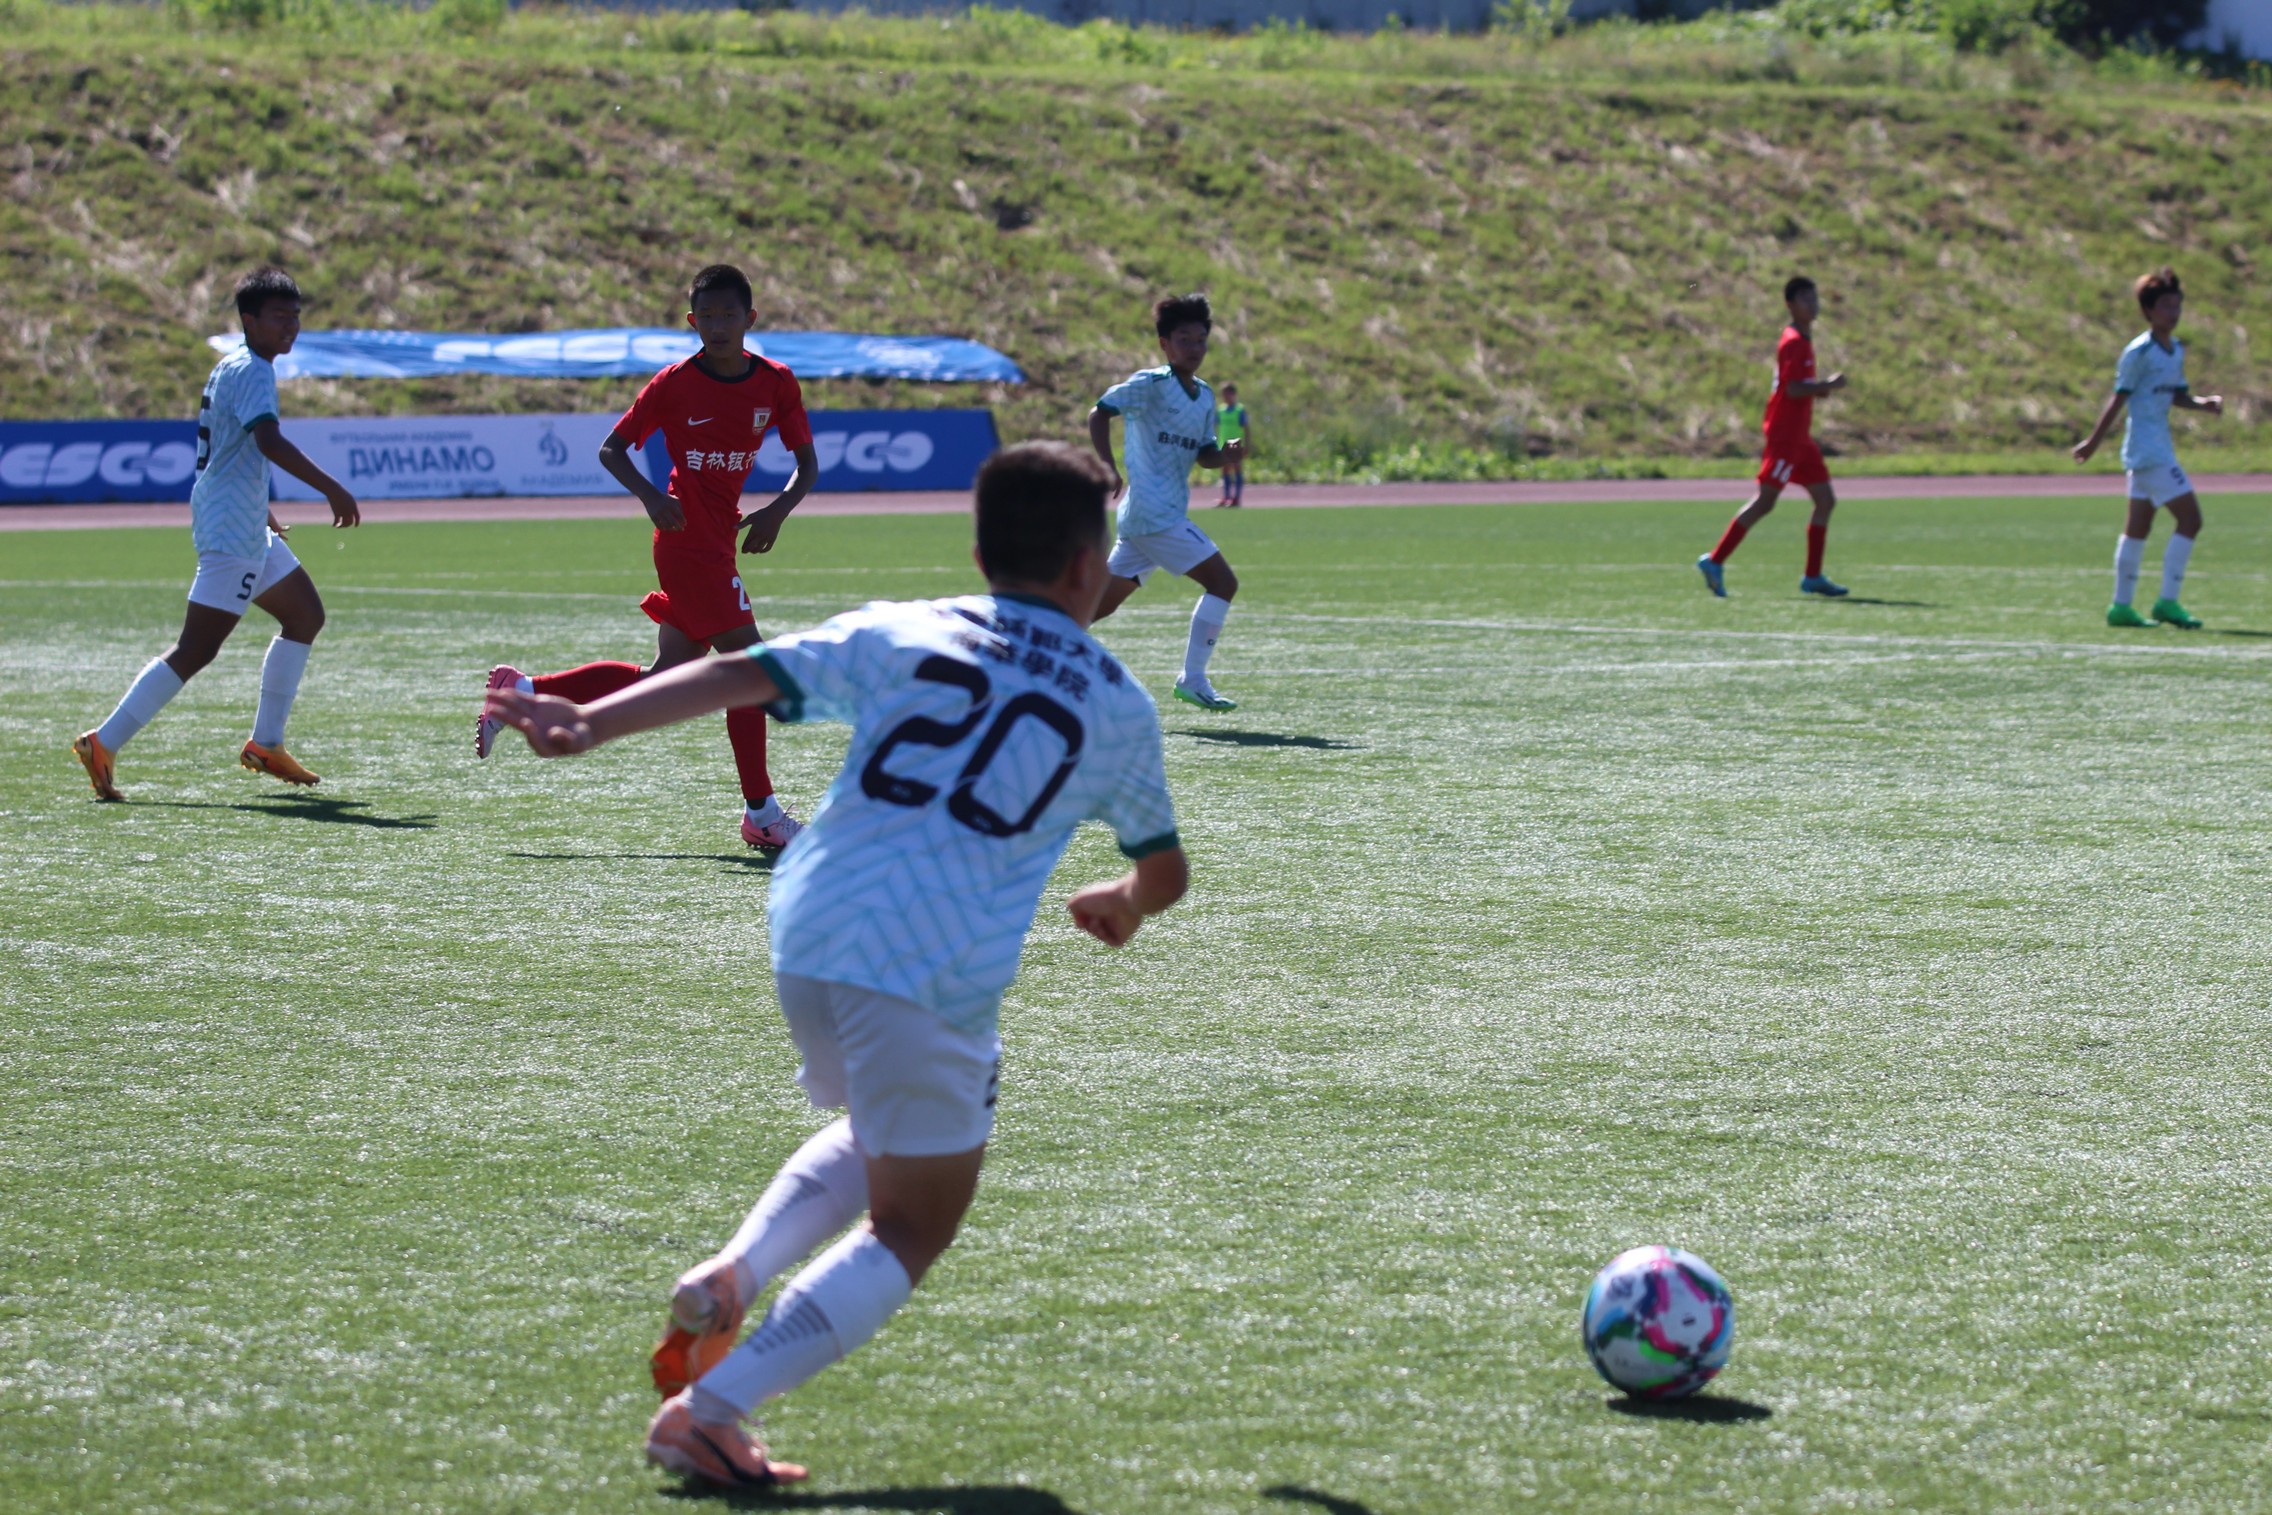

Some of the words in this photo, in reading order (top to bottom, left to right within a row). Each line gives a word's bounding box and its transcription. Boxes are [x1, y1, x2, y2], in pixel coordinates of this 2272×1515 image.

[0, 441, 197, 487] ESCO
[349, 445, 495, 479] ДИНАМО
[861, 654, 1084, 838] 20
